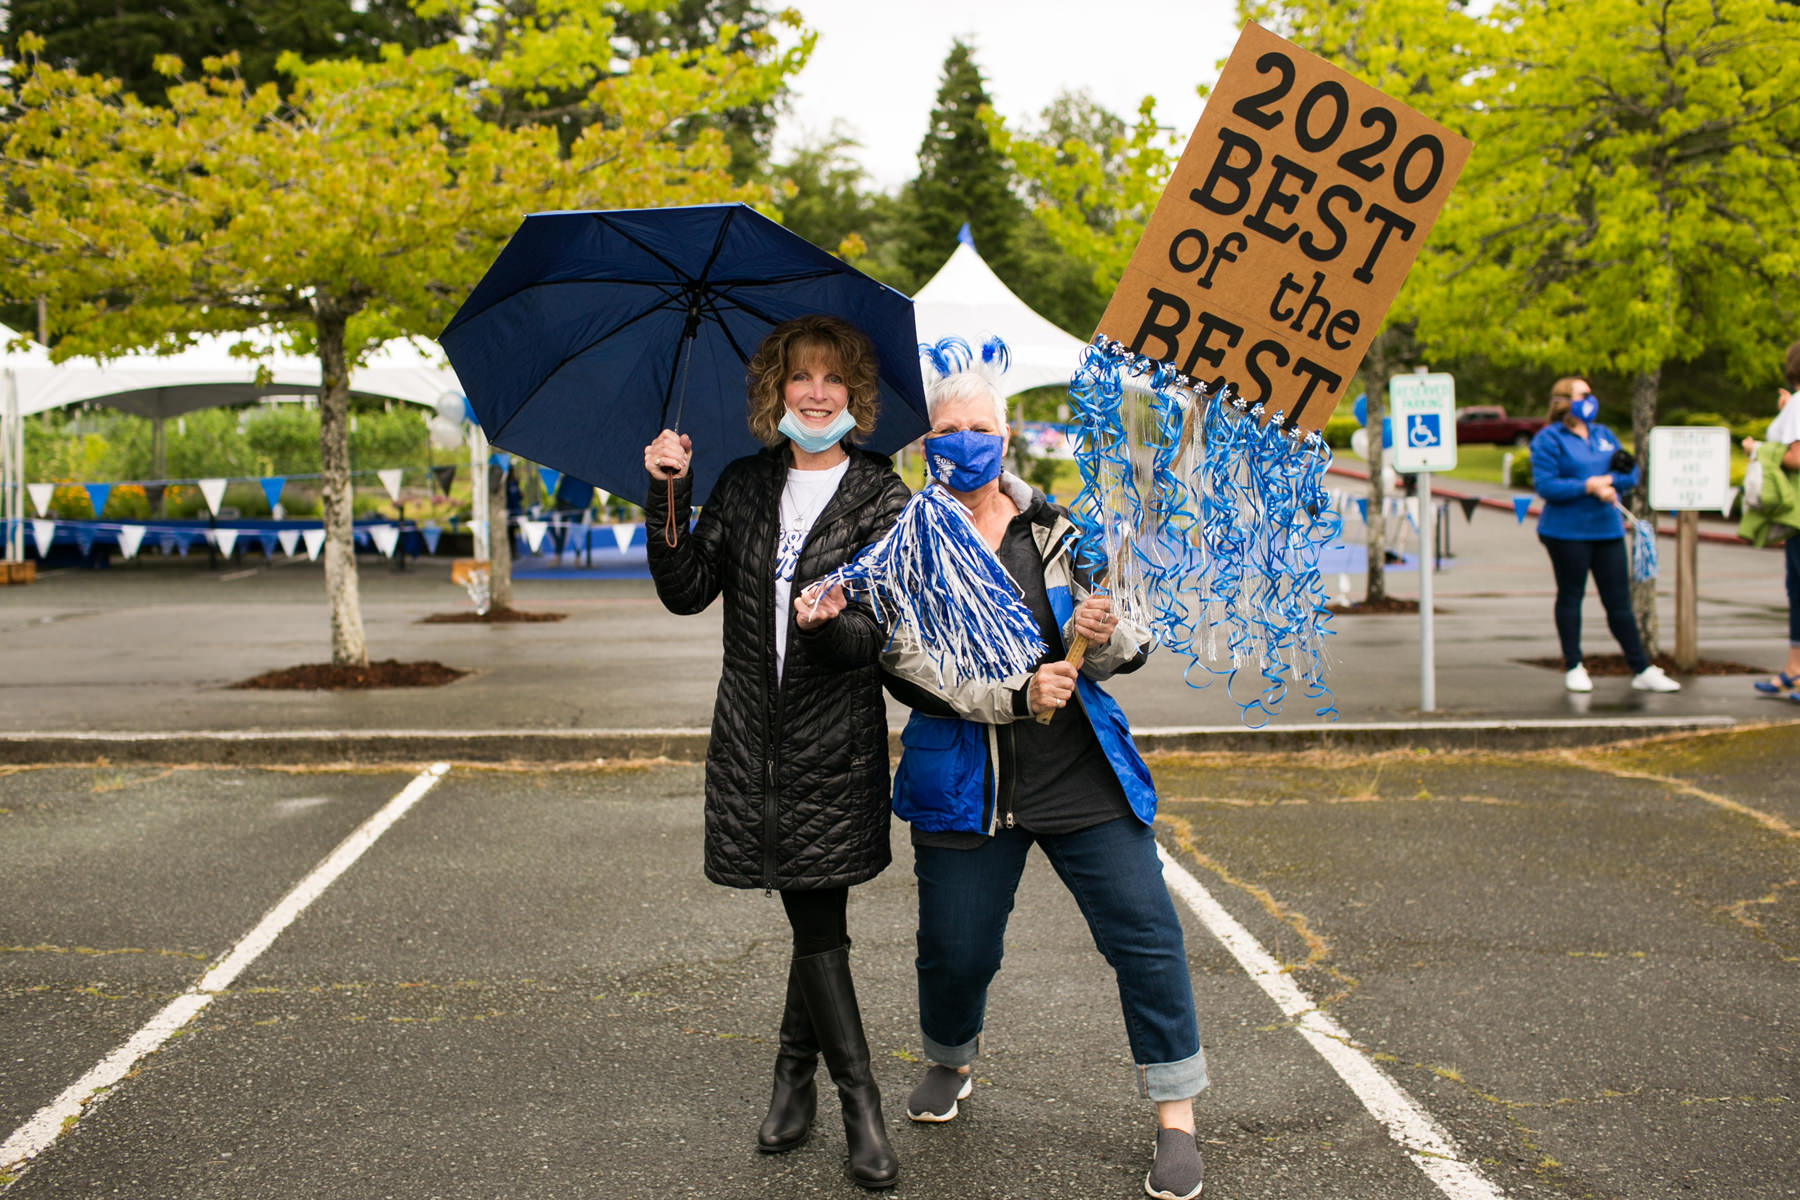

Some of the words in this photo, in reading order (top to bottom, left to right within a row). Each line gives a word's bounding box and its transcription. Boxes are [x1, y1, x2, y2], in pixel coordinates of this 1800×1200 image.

[1232, 52, 1444, 204] 2020
[1189, 127, 1416, 285] BEST
[1123, 287, 1342, 432] BEST
[1169, 228, 1248, 290] of
[1270, 271, 1360, 351] the
